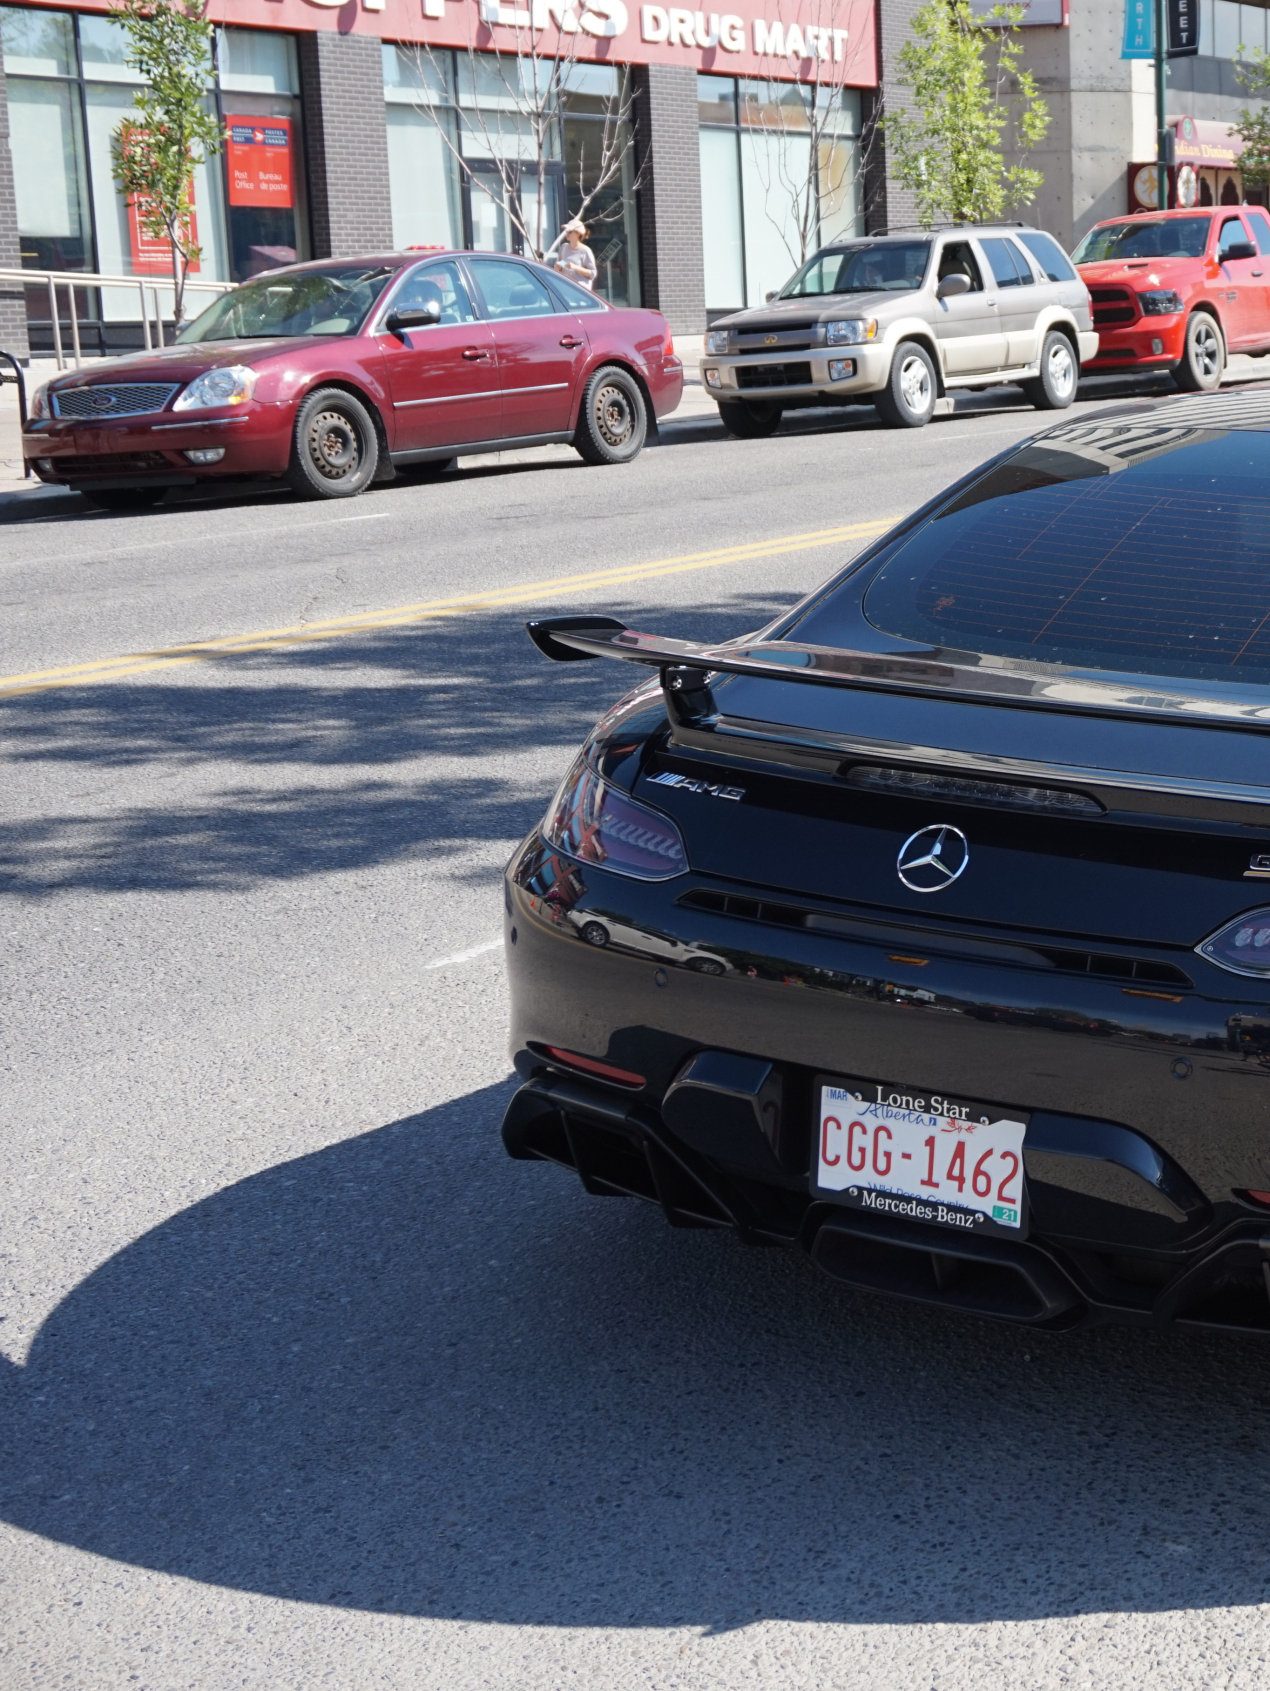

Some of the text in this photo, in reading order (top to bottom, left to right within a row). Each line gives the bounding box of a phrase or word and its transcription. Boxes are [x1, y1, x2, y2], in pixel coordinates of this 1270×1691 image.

[641, 4, 745, 52] DRUG
[753, 18, 849, 61] MART
[234, 170, 248, 179] Post
[259, 171, 282, 181] Bureau
[235, 180, 254, 189] Office
[260, 182, 288, 191] de poste
[673, 779, 746, 801] AMG
[829, 1089, 848, 1102] MAR
[876, 1085, 970, 1120] Lone Star
[856, 1102, 928, 1126] Alberta
[821, 1116, 1019, 1205] CGG-1462
[861, 1190, 974, 1228] Mercedes-Benz
[1002, 1208, 1015, 1222] 21
